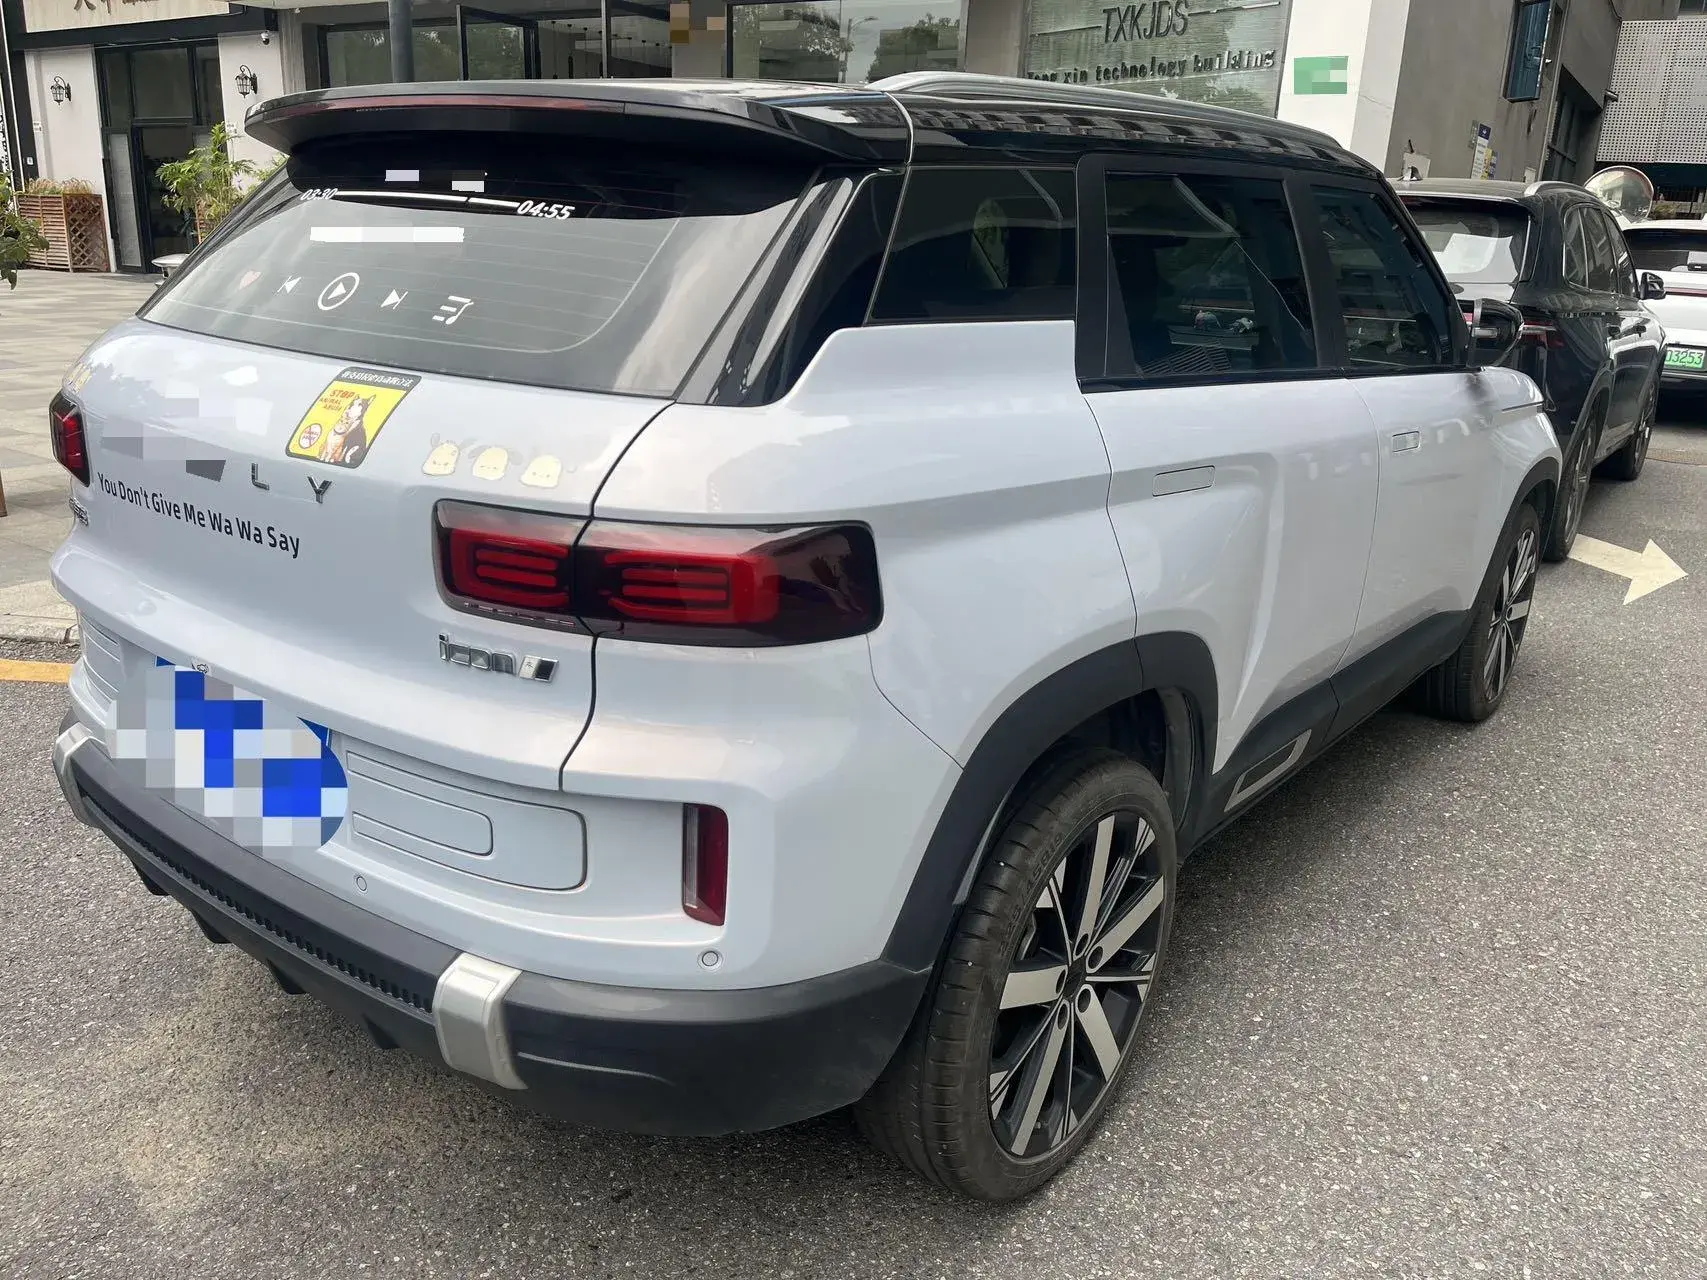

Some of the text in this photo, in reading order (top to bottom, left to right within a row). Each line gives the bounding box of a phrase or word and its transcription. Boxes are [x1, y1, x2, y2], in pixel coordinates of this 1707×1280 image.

[1103, 0, 1189, 44] TXKJDS
[1096, 57, 1187, 82] technology
[1193, 49, 1275, 73] building
[517, 200, 575, 220] 04:55
[329, 389, 355, 399] STOP
[98, 472, 300, 559] You Don't Give Me Wa Wa Say
[438, 633, 516, 677] icon
